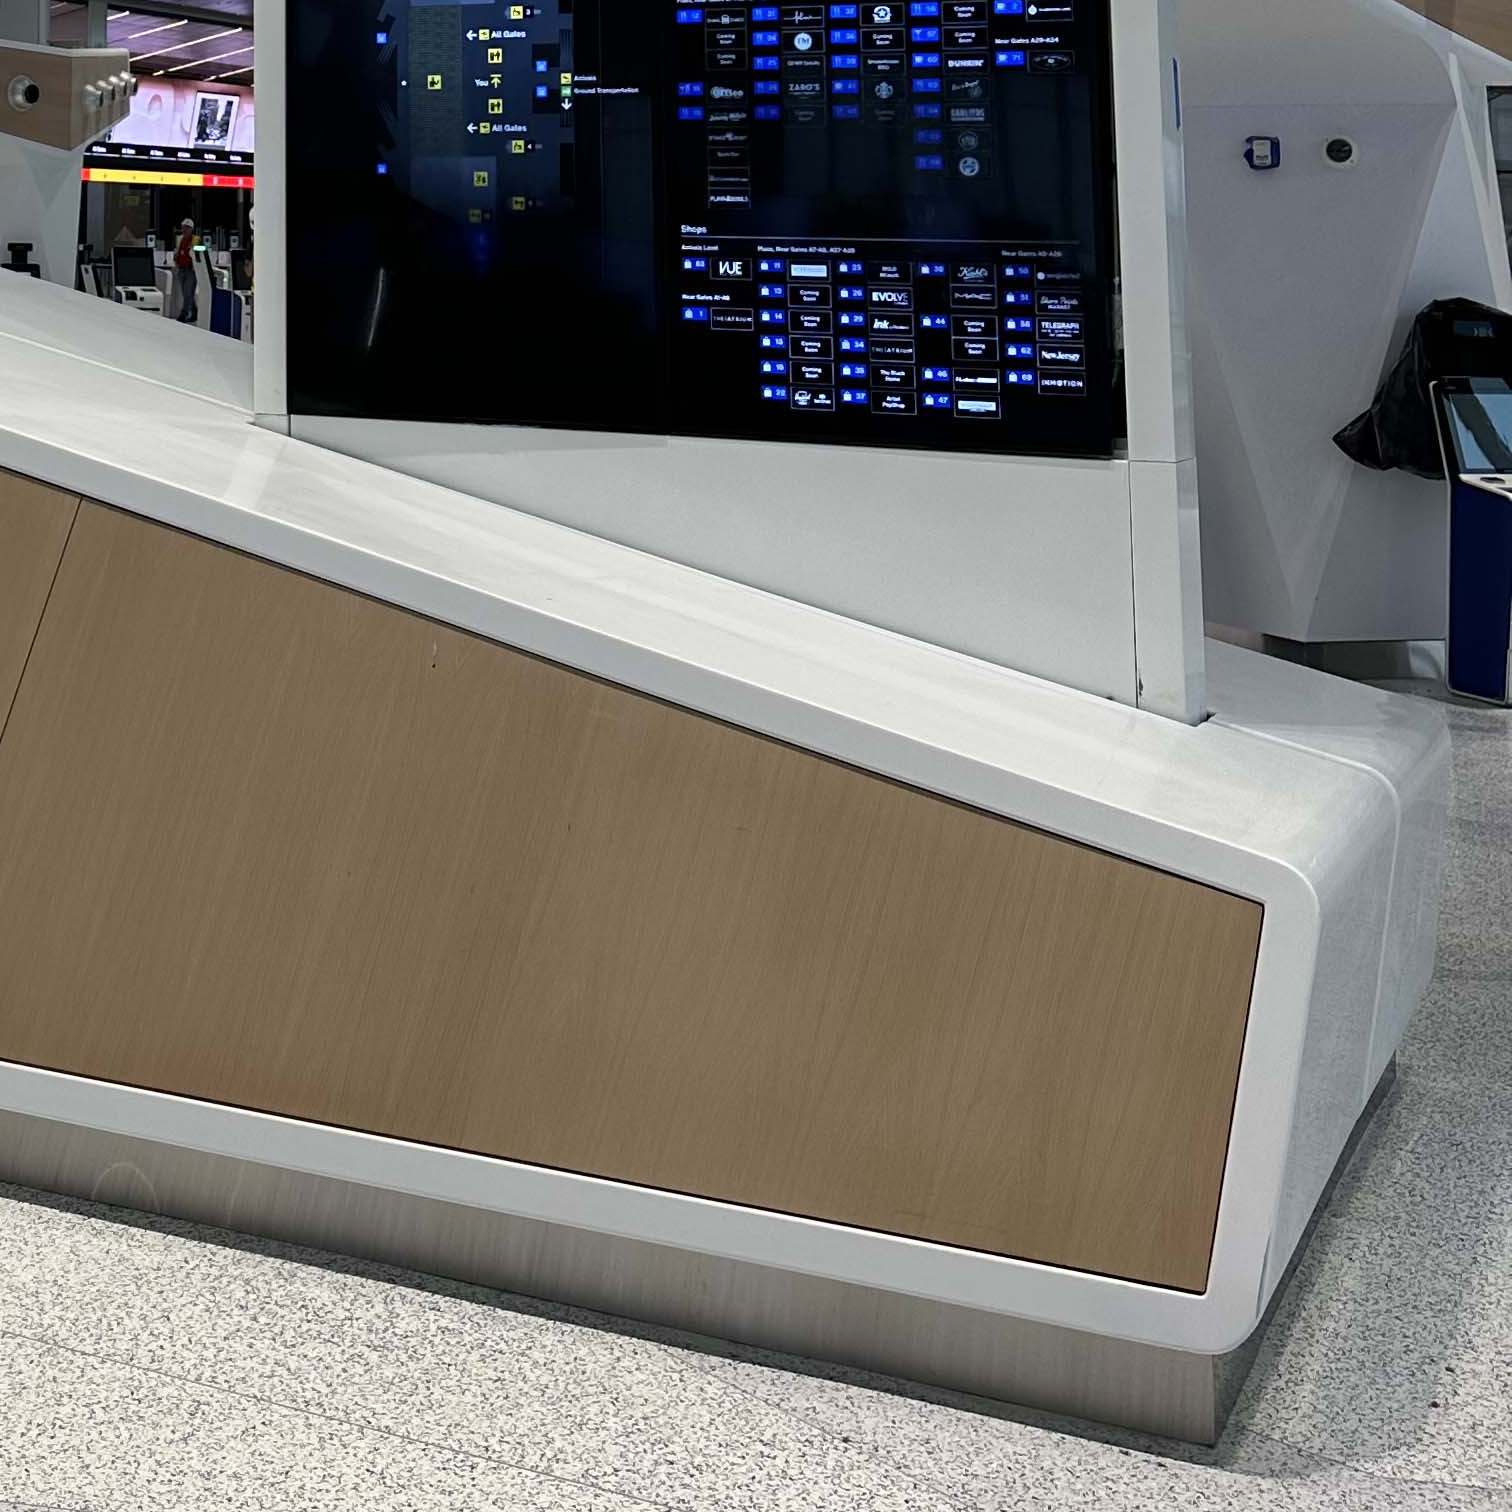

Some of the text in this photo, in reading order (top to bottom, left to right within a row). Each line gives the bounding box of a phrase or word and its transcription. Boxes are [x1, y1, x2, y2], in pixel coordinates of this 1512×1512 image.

[491, 29, 527, 39] All Gates
[474, 78, 489, 88] You
[491, 123, 527, 133] All Gates
[680, 224, 707, 234] Shops
[871, 292, 909, 302] EVOLVE
[873, 318, 890, 330] ink
